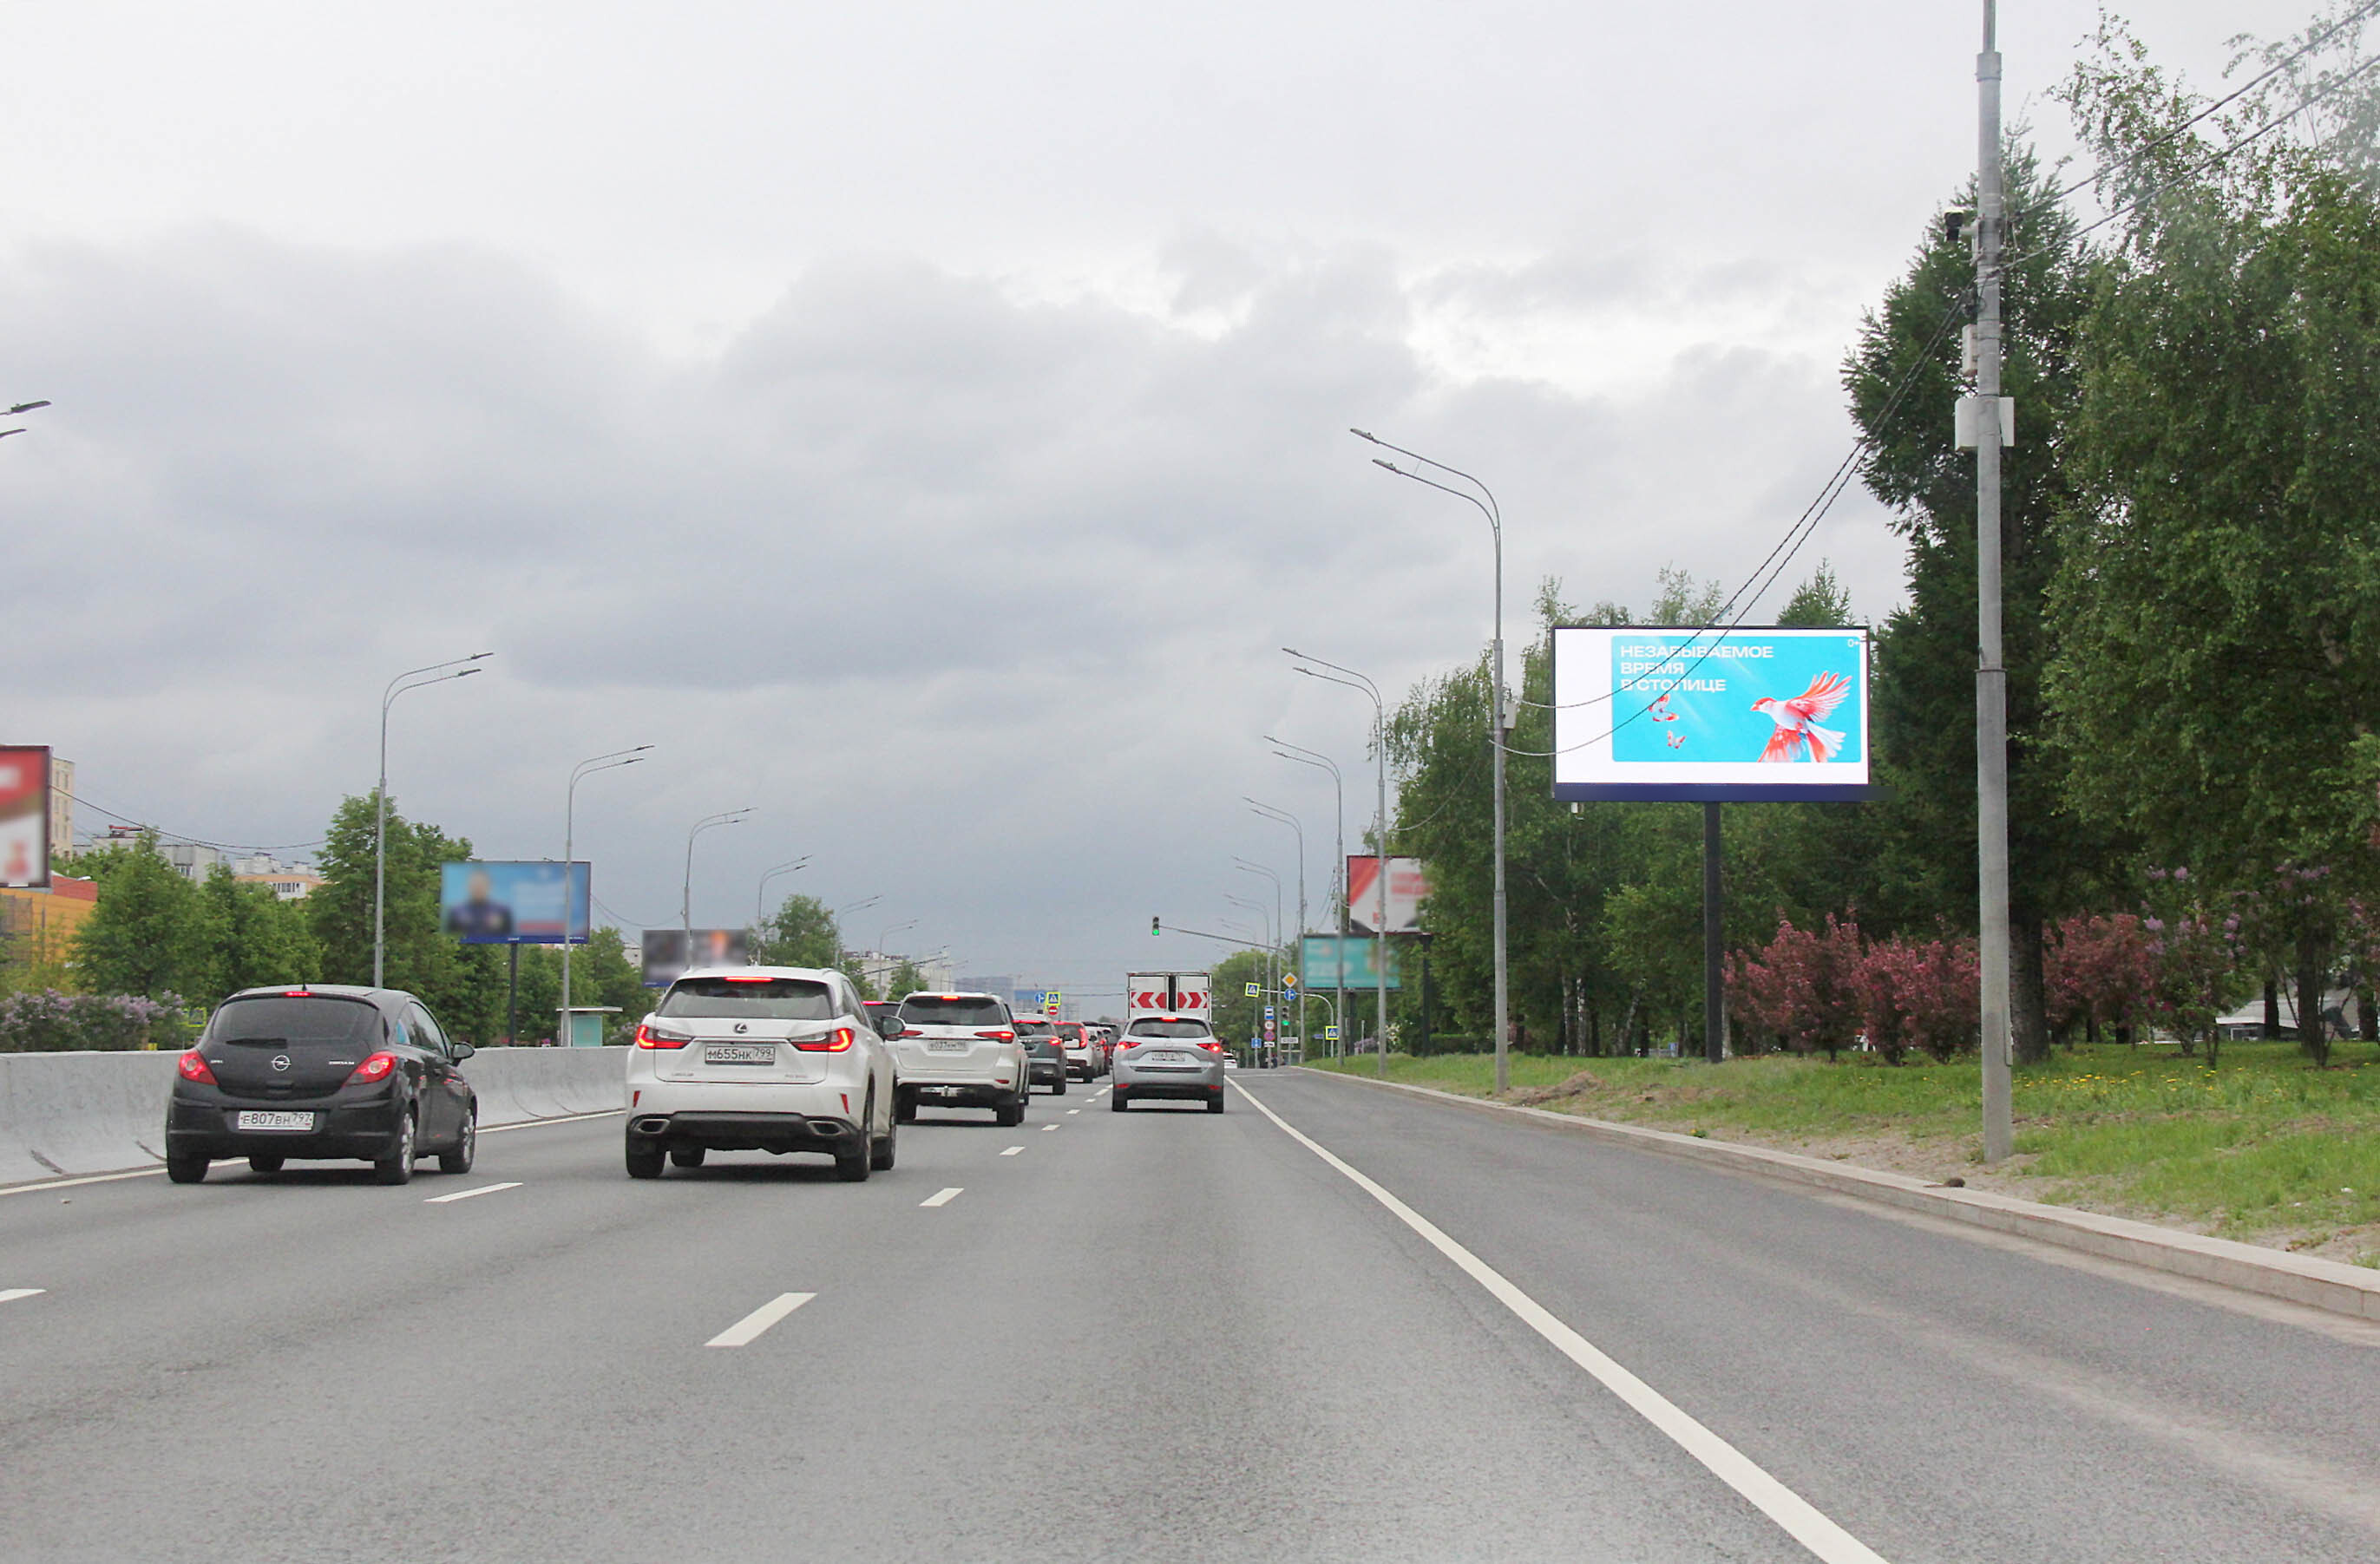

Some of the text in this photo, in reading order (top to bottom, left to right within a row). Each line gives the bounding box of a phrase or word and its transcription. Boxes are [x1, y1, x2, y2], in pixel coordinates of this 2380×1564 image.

[1620, 645, 1774, 658] НЕЗАБЫВАЕМОЕ
[1620, 661, 1685, 675] ВРЕМЯ
[1620, 678, 1727, 693] В СТОЛИЦЕ
